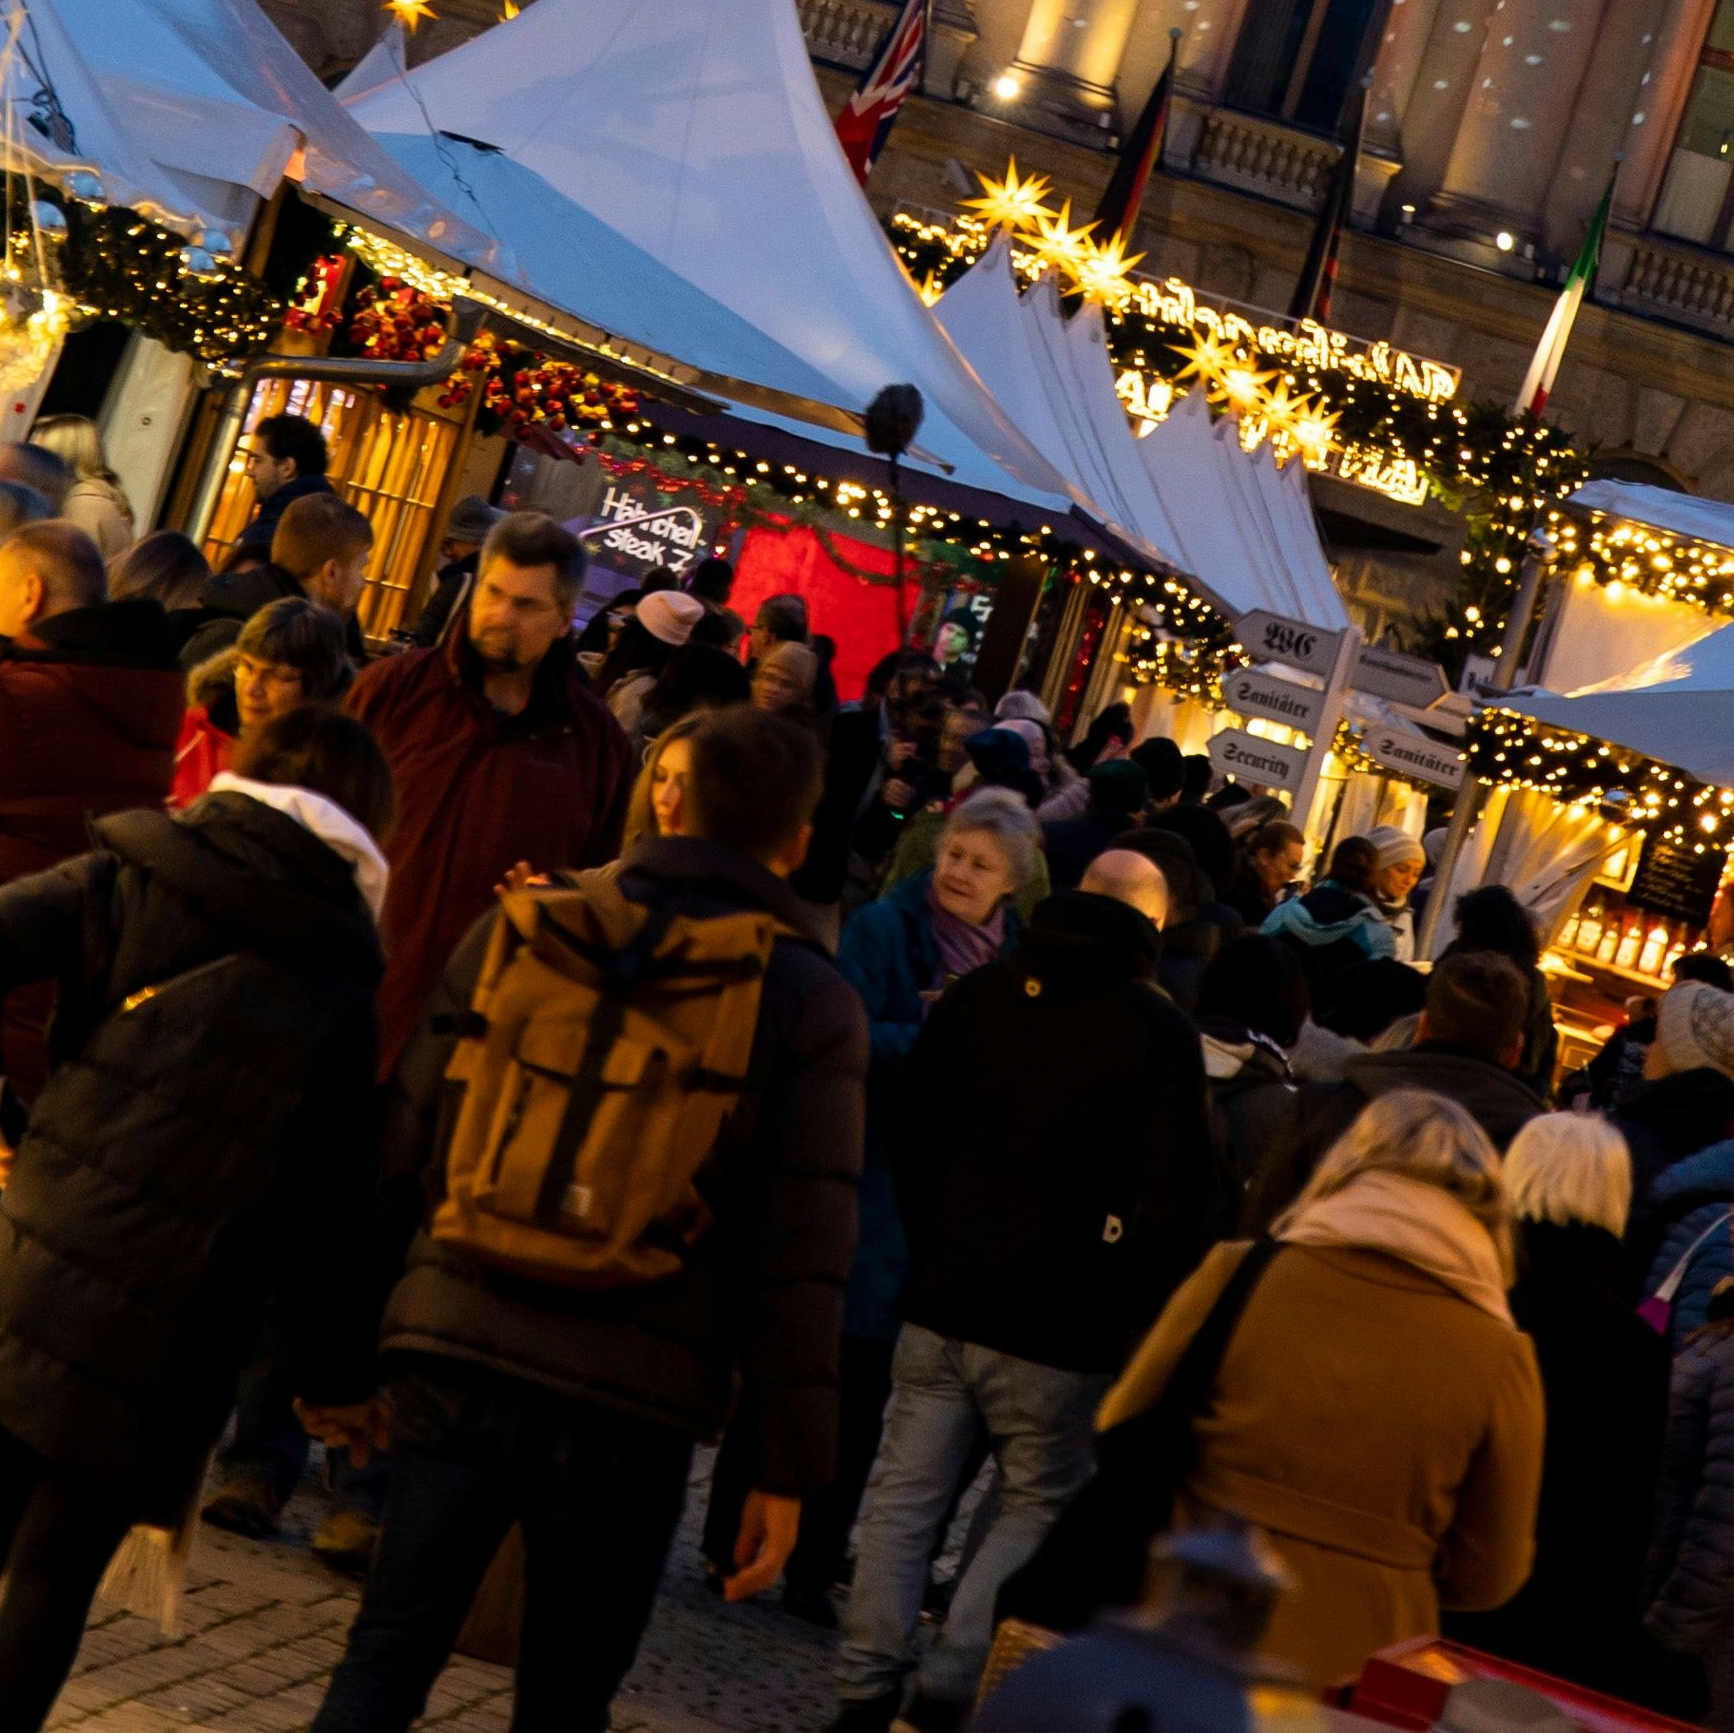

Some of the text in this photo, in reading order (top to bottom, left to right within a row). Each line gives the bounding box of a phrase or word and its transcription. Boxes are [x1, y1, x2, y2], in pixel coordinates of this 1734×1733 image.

[601, 487, 707, 549] Hähnche-
[603, 528, 666, 566] steak
[1263, 620, 1317, 662] WC
[1236, 682, 1310, 719] Sanitäter
[1222, 742, 1290, 780] Security
[1378, 738, 1459, 778] Sanitäter
